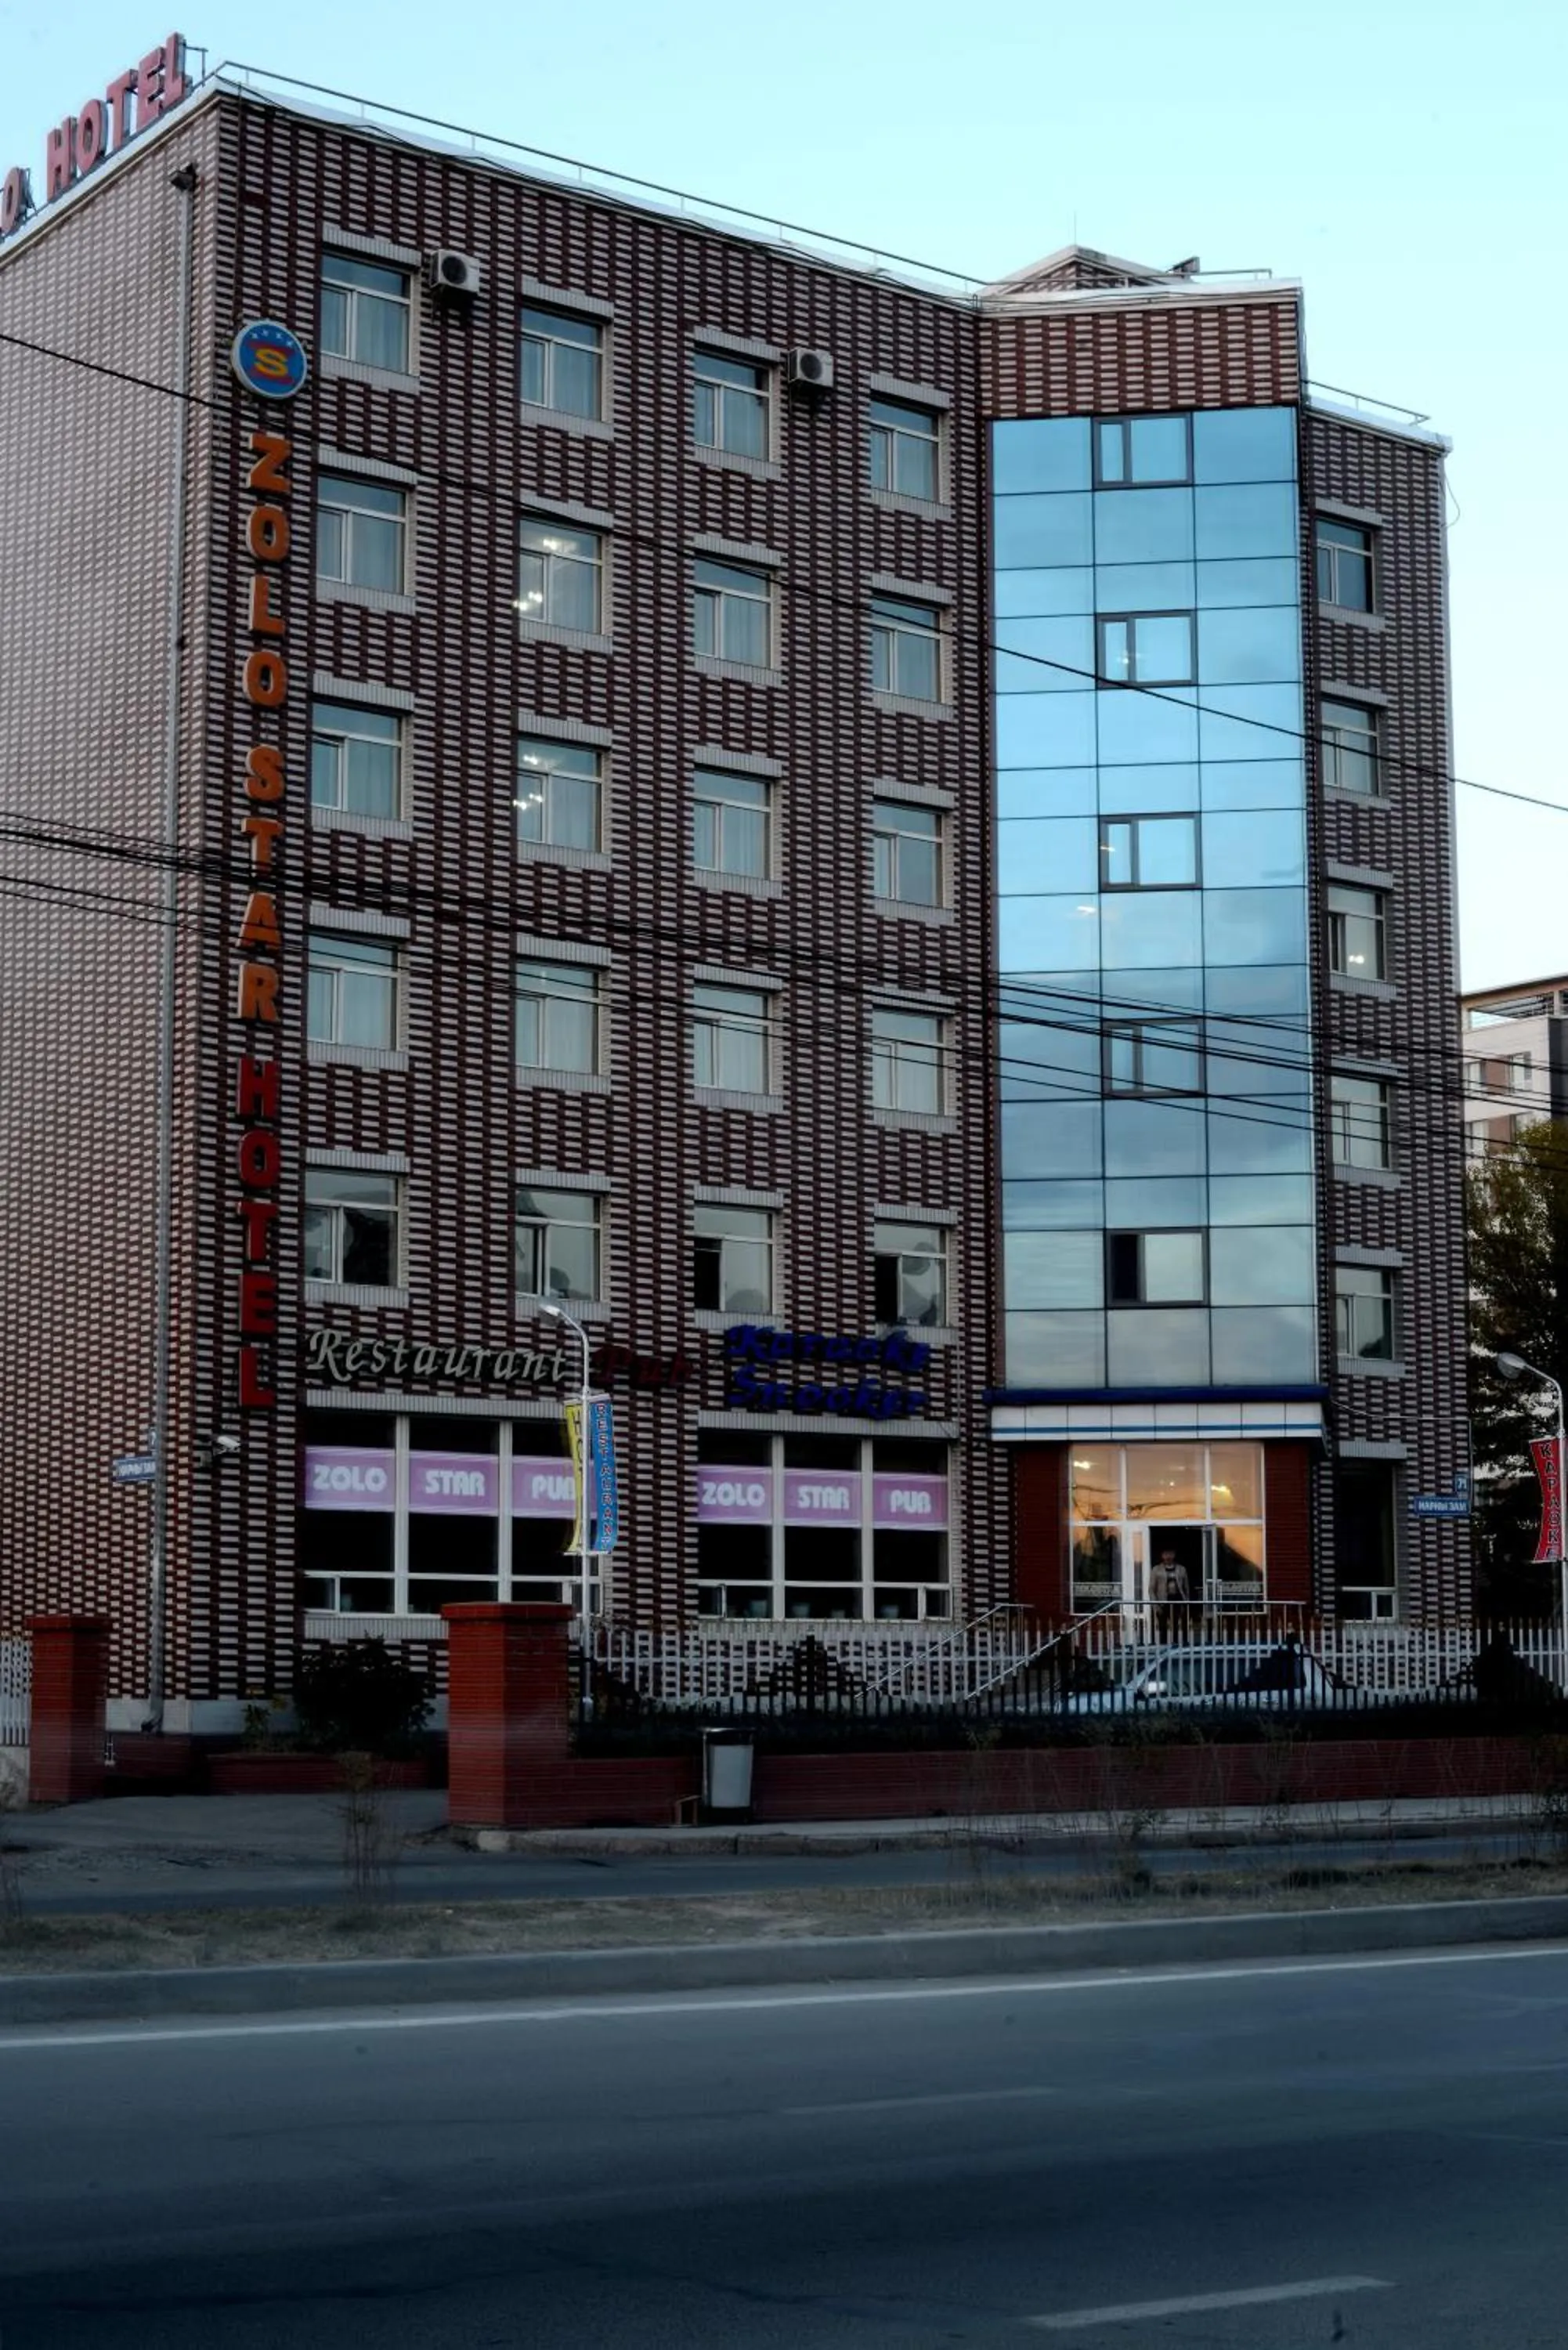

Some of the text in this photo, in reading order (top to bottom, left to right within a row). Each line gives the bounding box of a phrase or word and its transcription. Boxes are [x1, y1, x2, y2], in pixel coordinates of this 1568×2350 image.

[47, 32, 190, 203] HOTEL
[237, 1058, 281, 1408] HOTEL
[306, 1329, 568, 1383] Restaurant
[313, 1464, 388, 1492] ZOLO
[425, 1470, 486, 1497] STAR
[701, 1481, 932, 1515] ZOLO STAR PUB
